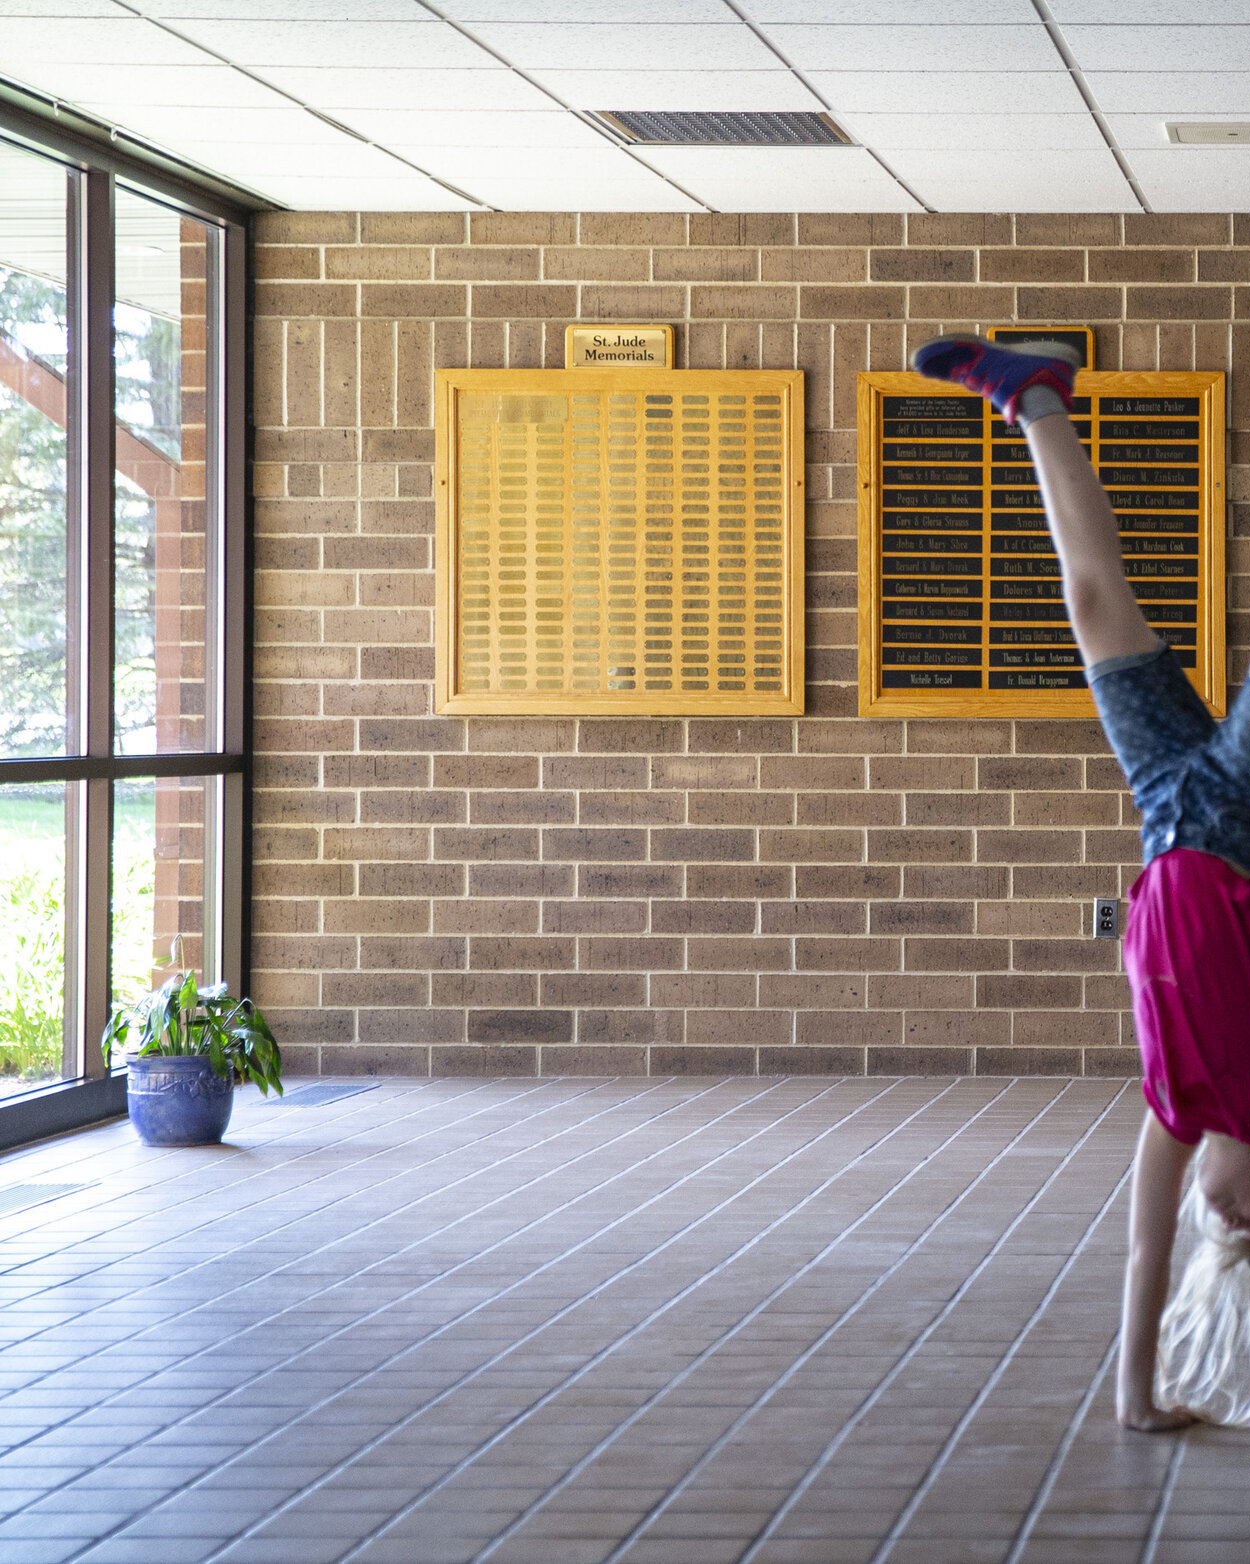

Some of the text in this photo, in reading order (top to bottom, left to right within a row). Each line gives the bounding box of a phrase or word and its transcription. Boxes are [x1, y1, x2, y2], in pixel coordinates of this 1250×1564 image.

[593, 335, 646, 347] St. Jude
[585, 349, 655, 361] Memorials
[1112, 400, 1124, 412] Leo
[897, 493, 919, 507] Peggy
[1003, 562, 1023, 574] Ruth
[1003, 584, 1033, 596] Dolores
